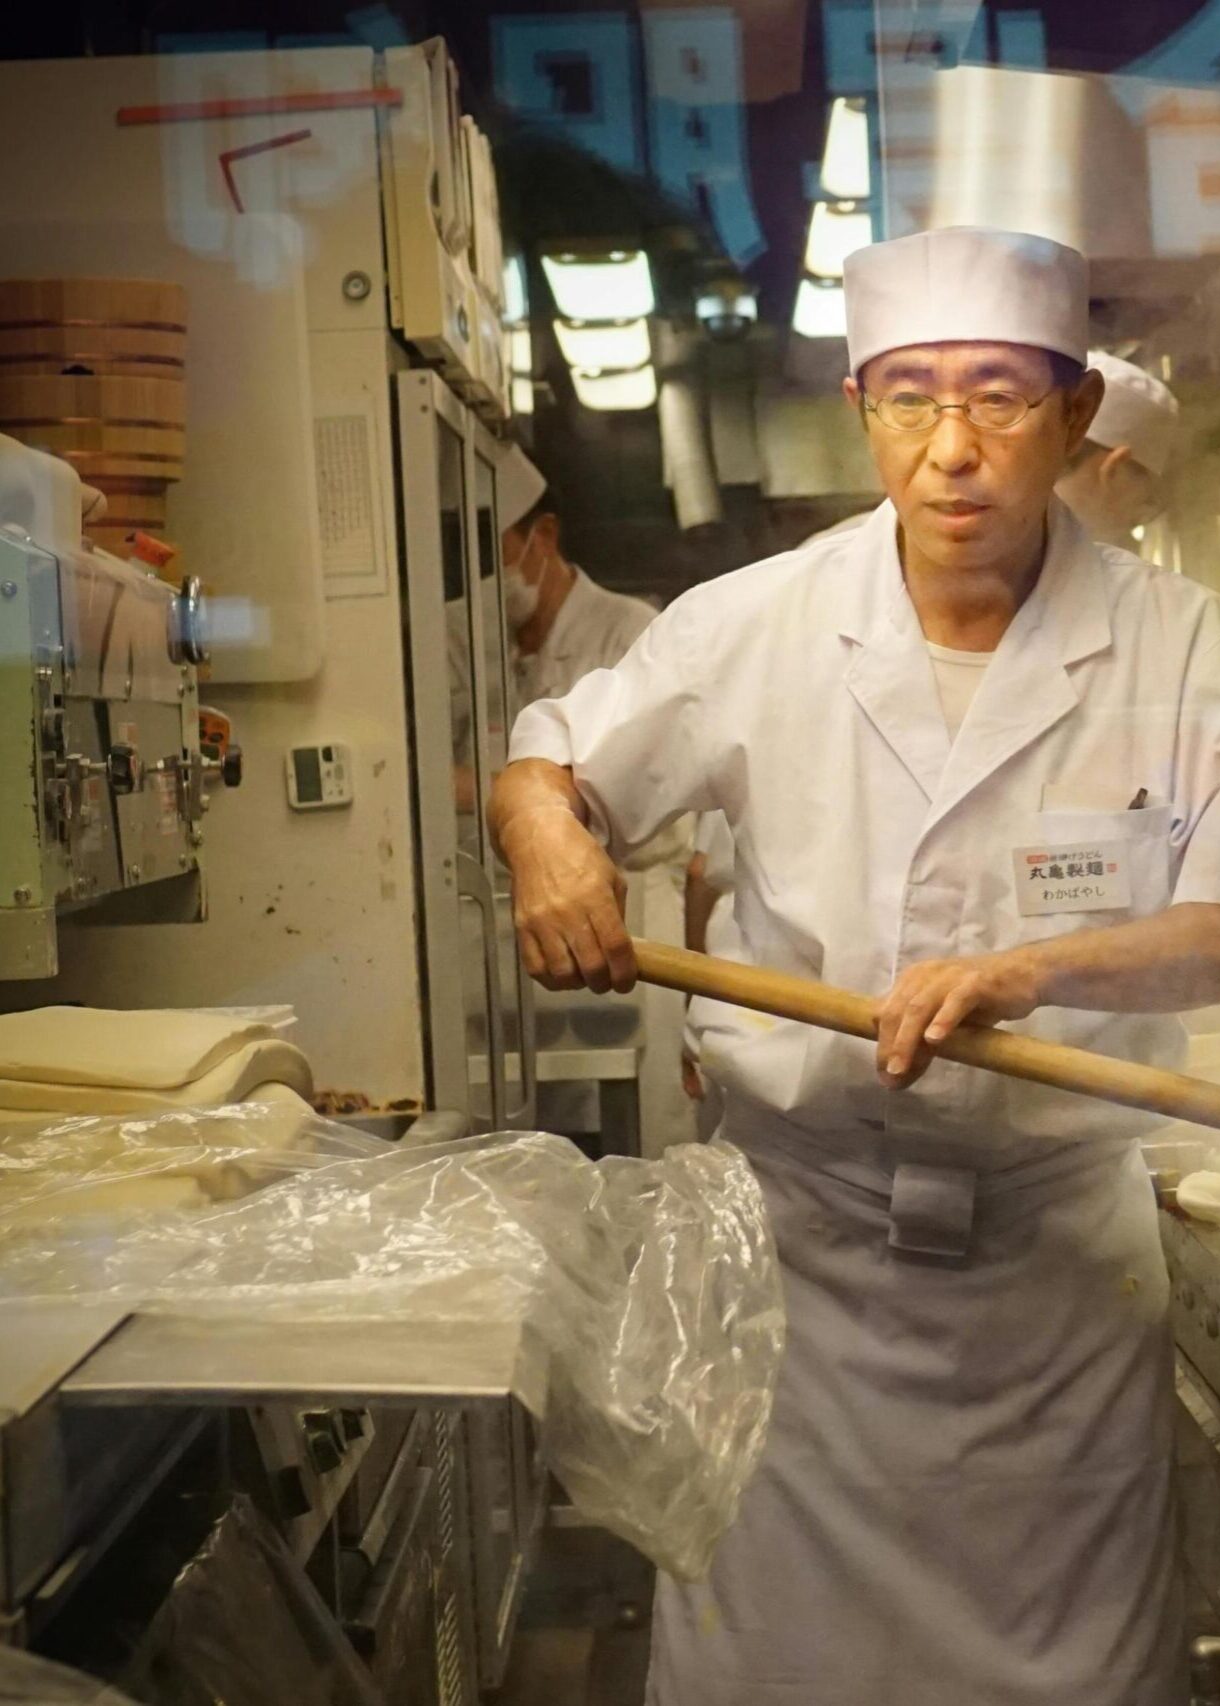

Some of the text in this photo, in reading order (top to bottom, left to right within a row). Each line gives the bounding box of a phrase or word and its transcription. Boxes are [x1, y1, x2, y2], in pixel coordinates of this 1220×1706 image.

[1030, 861, 1103, 879] 丸亀製麺
[1043, 887, 1104, 900] わかばやし
